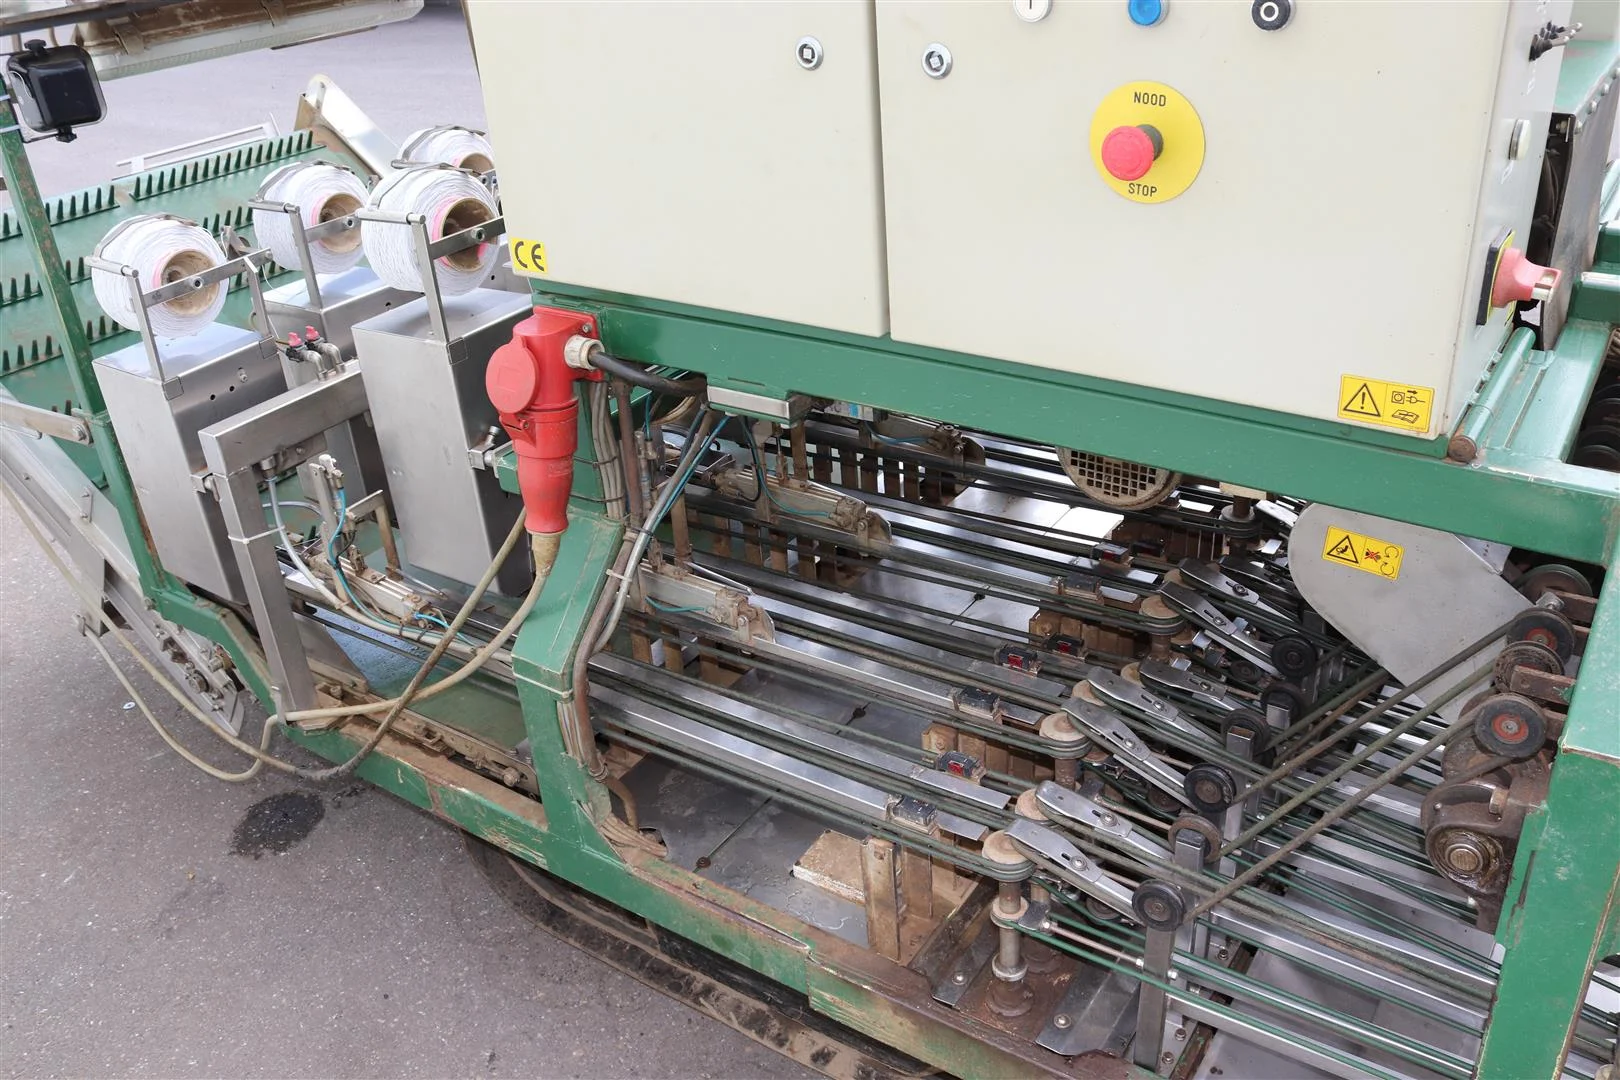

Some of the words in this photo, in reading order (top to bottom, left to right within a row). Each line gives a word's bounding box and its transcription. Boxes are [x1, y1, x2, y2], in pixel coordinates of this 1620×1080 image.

[1133, 91, 1167, 107] NOOD
[1128, 182, 1158, 197] STOP
[514, 240, 545, 272] CE
